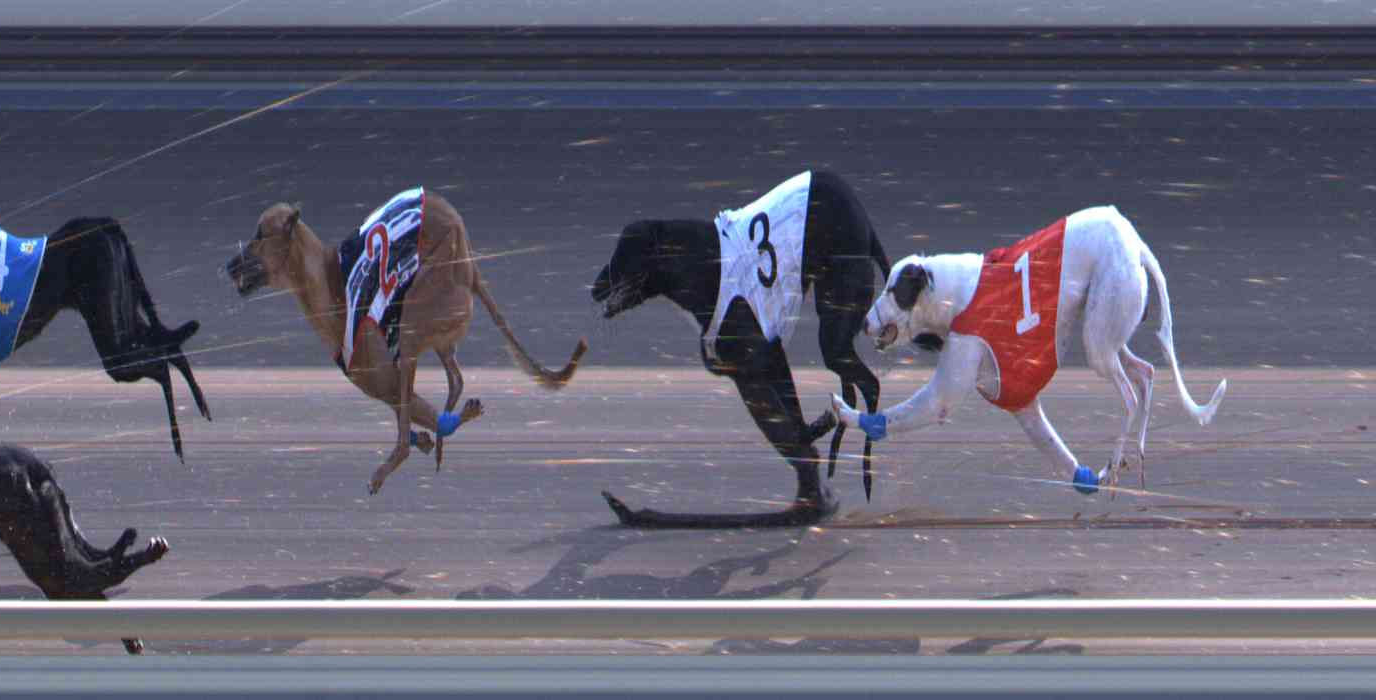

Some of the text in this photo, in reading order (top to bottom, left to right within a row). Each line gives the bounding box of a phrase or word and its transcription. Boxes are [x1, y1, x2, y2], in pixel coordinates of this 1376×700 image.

[366, 222, 398, 299] 2
[748, 211, 777, 288] 3
[1014, 251, 1041, 336] 1
